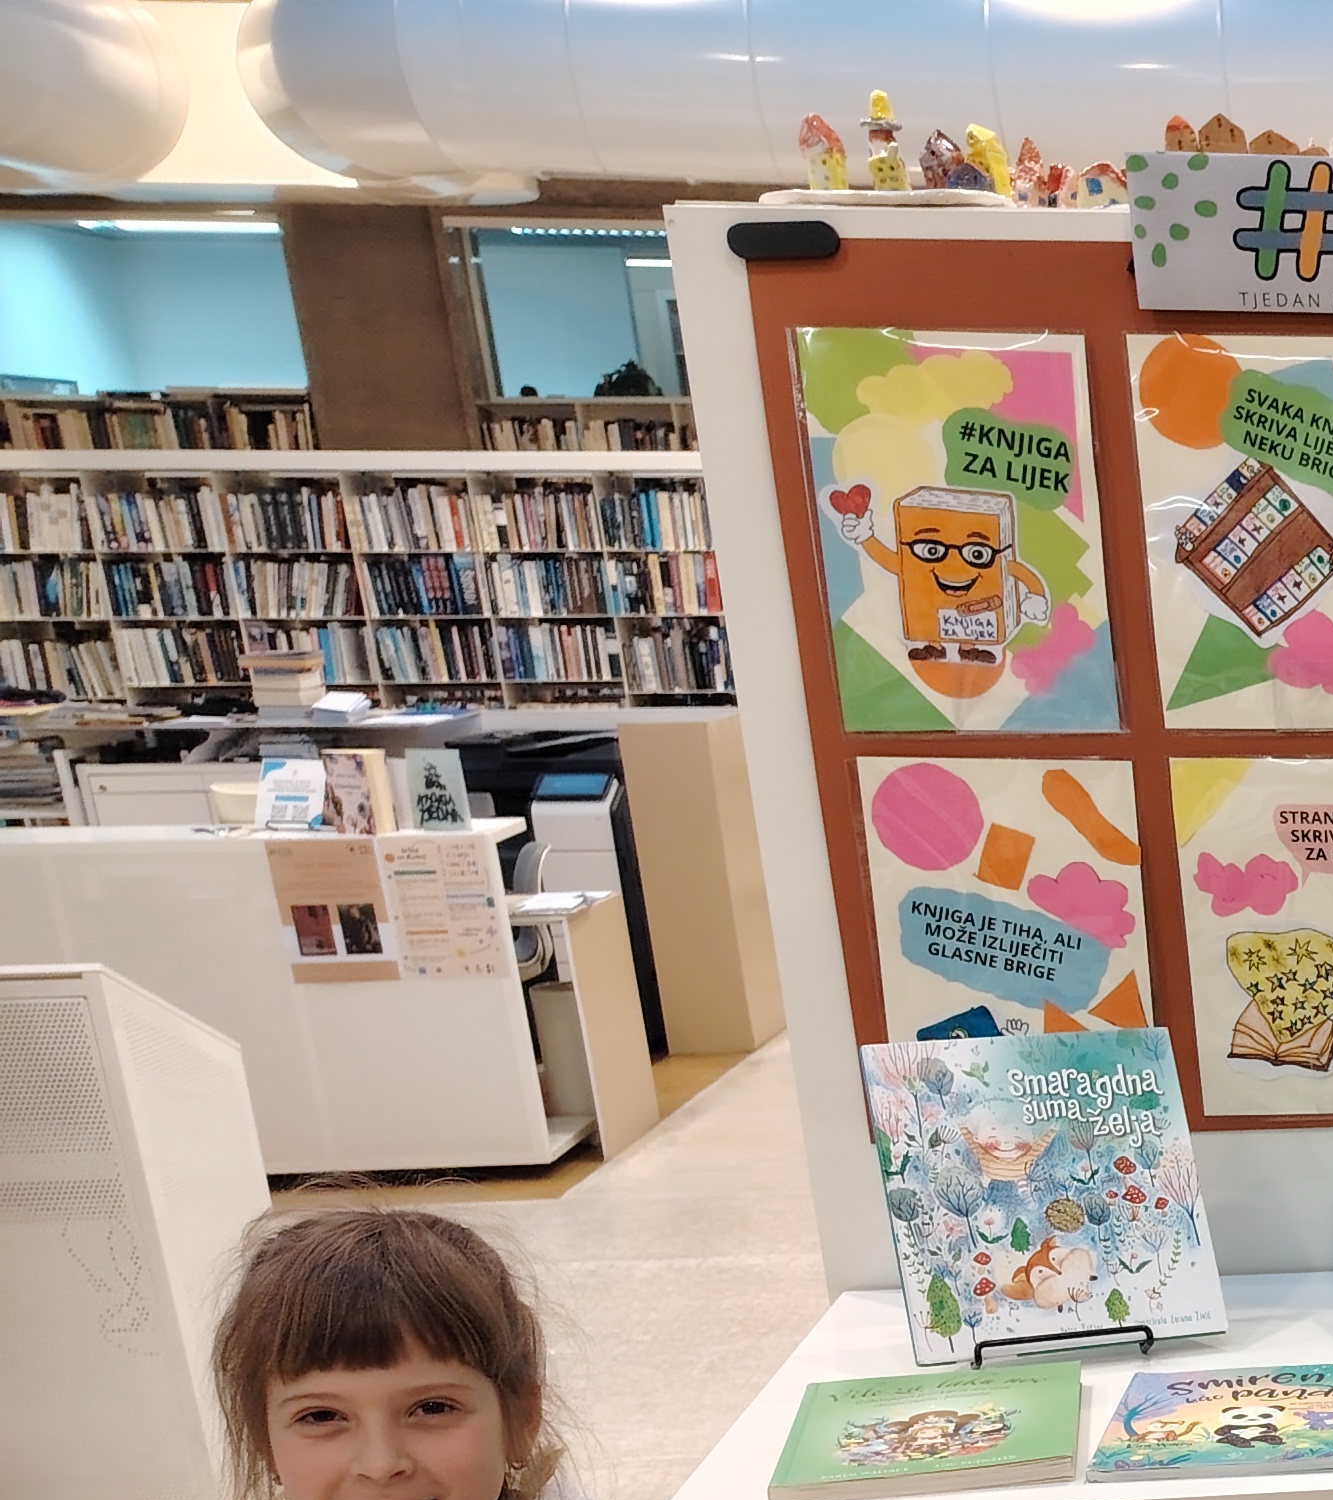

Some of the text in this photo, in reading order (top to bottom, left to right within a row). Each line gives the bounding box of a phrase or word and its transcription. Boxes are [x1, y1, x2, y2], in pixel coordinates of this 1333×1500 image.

[1239, 292, 1320, 309] TJEDAN
[1233, 405, 1300, 443] SKRIVA
[1244, 388, 1306, 424] SVAKA
[959, 421, 1071, 463] #KNJIGA
[1243, 431, 1294, 461] NEKU
[963, 452, 1070, 494] ZA LIJEK
[943, 616, 995, 630] KNJIGA
[1305, 847, 1328, 861] ZA
[911, 901, 1082, 950] KNJIGA JE TIHA, ALI
[923, 917, 1064, 965] MOŽE IZLIJEČITI
[927, 941, 1056, 983] GLASNE BRIGE
[1009, 1064, 1165, 1110] Smaragdna
[1022, 1095, 1163, 1148] šuma želja
[1166, 1371, 1325, 1396] Smiren
